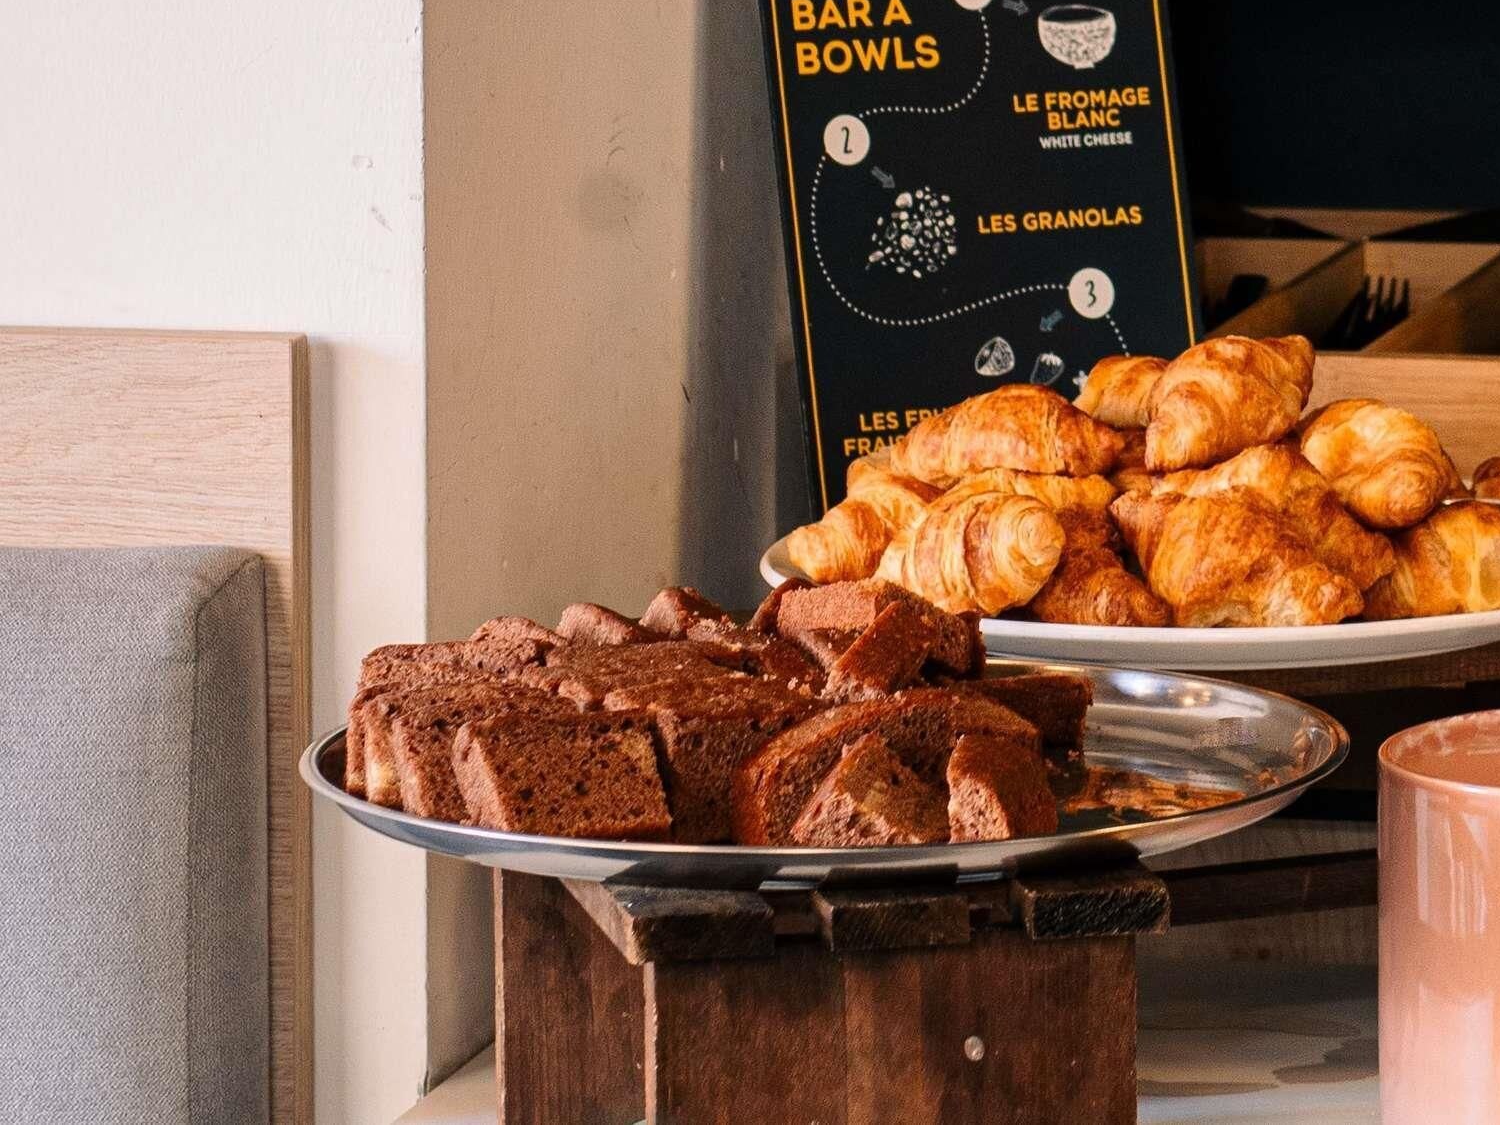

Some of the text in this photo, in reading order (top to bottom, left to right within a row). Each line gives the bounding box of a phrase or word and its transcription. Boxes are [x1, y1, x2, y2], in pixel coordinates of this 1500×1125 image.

[796, 34, 940, 76] BOWLS
[1013, 87, 1151, 113] LE FROMAGE
[1047, 109, 1121, 130] BLANC
[841, 126, 853, 153] 2
[1039, 131, 1133, 149] WHITE CHEESE
[977, 205, 1143, 234] LES GRANOLAS
[1085, 281, 1097, 307] 3
[859, 411, 900, 431] LES
